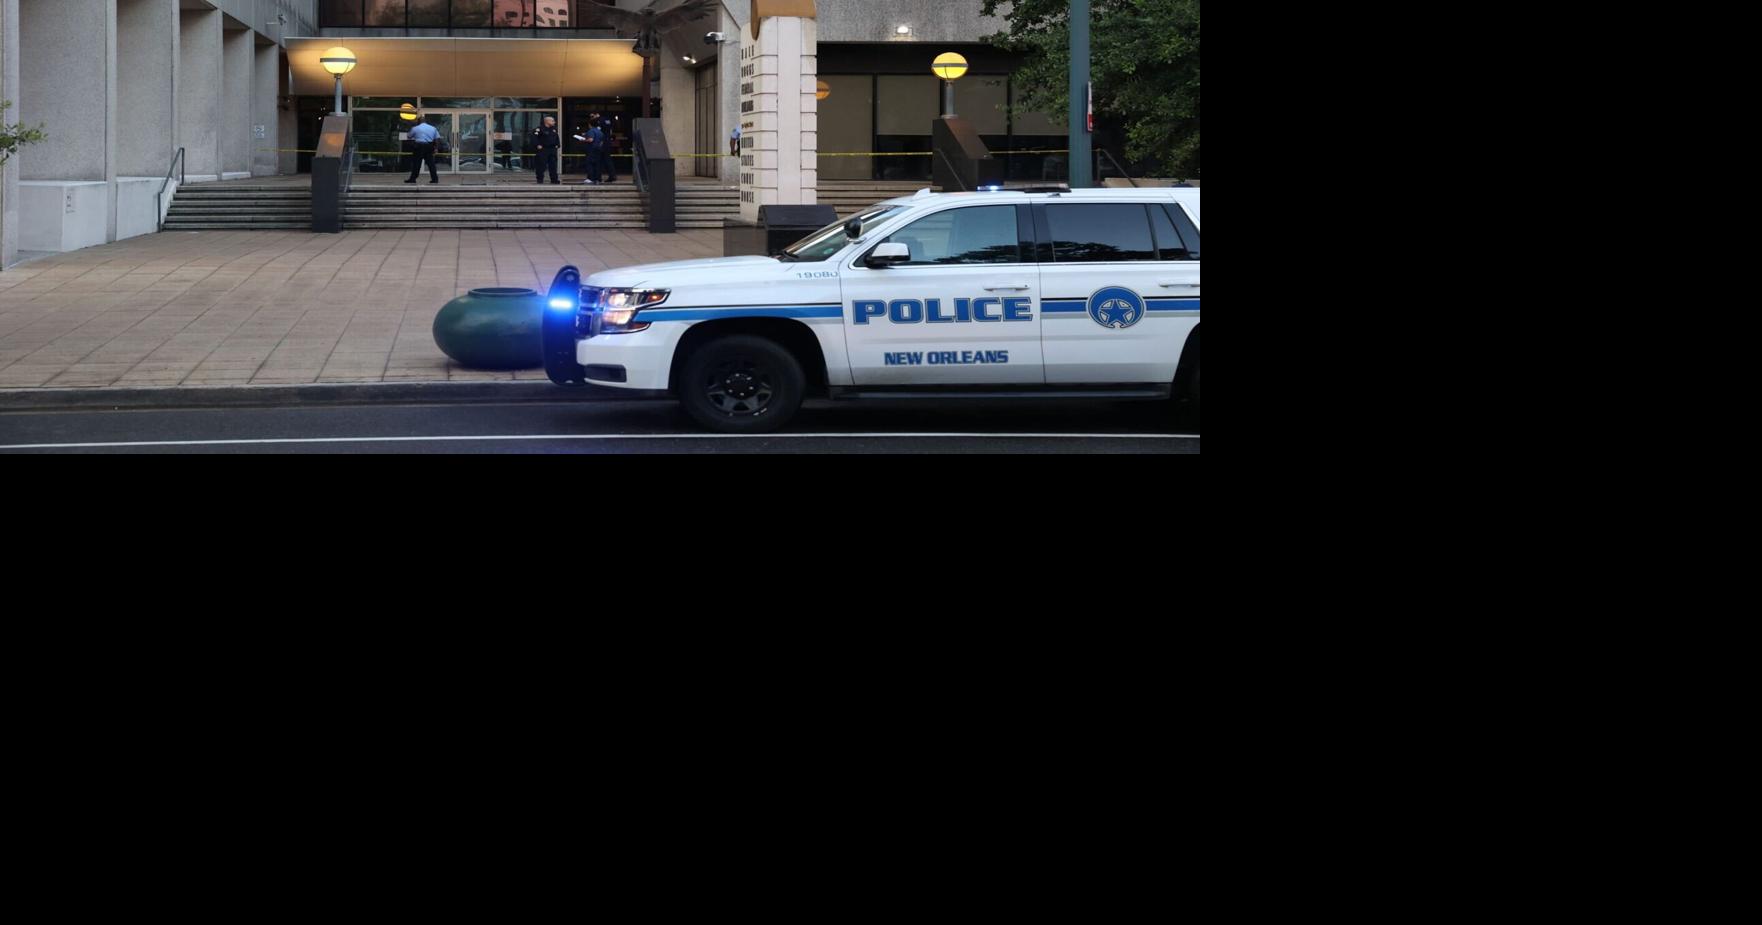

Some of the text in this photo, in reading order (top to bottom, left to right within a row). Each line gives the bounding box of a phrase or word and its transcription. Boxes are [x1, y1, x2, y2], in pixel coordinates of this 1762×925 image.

[796, 271, 839, 279] 19080
[852, 296, 1033, 325] POLICE
[884, 350, 1009, 366] NEW ORLEANS
